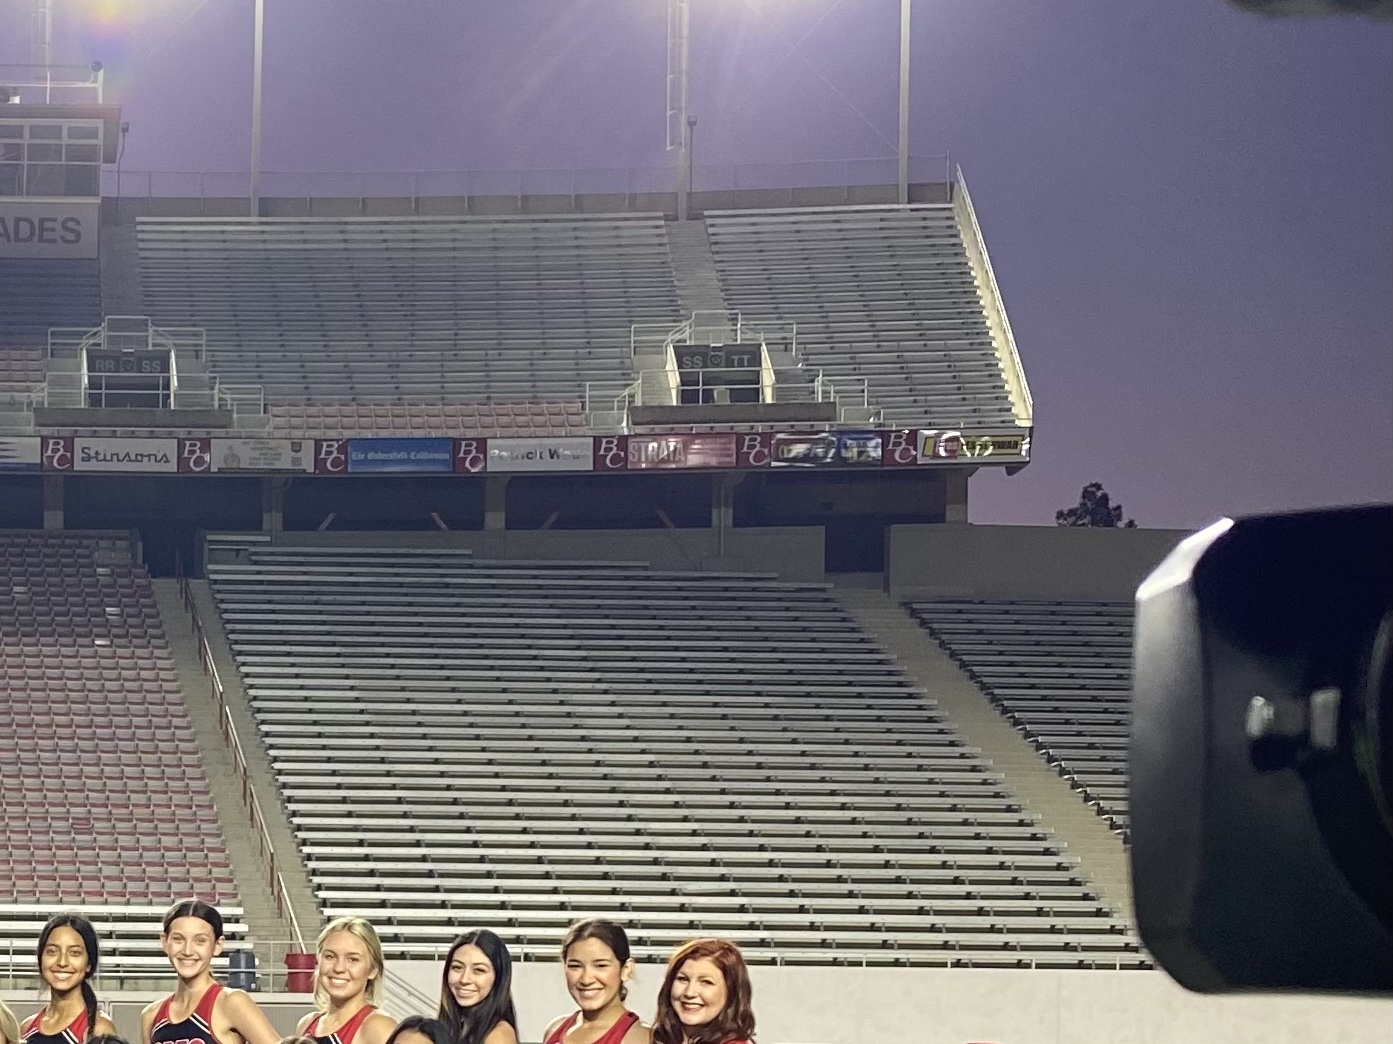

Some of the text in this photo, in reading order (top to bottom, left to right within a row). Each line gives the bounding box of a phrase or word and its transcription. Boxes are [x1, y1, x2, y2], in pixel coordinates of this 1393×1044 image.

[95, 359, 161, 372] RR SS
[682, 354, 752, 368] SS TT
[80, 446, 171, 464] Stinson's
[628, 440, 686, 463] STRATA
